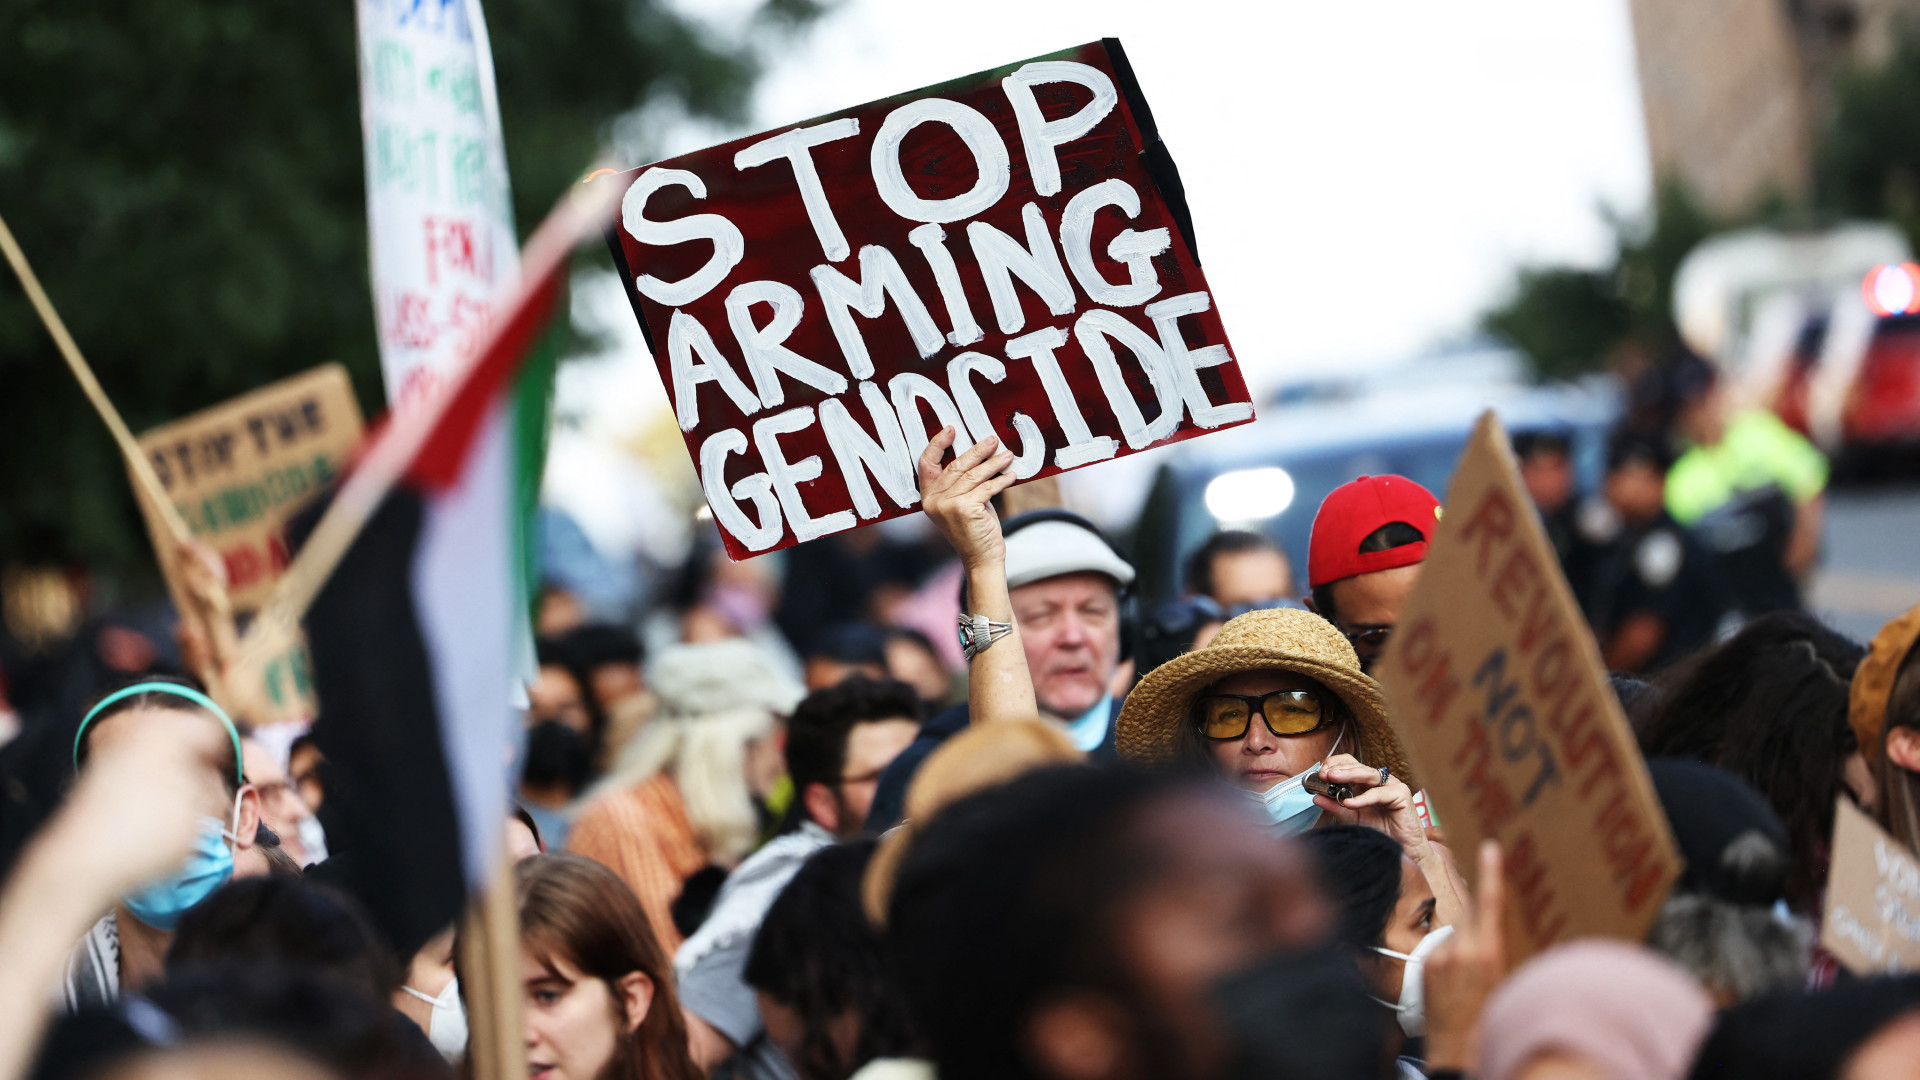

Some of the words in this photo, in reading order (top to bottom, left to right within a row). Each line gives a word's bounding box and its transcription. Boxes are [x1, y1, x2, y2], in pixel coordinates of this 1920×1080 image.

[622, 61, 1118, 307] STOP
[667, 178, 1171, 432] ARMING
[700, 291, 1254, 551] GENOCIDE
[1401, 617, 1461, 727] ON
[1453, 714, 1515, 837] THE
[1459, 484, 1670, 914] REVOLUTION
[1471, 646, 1560, 807] NOT
